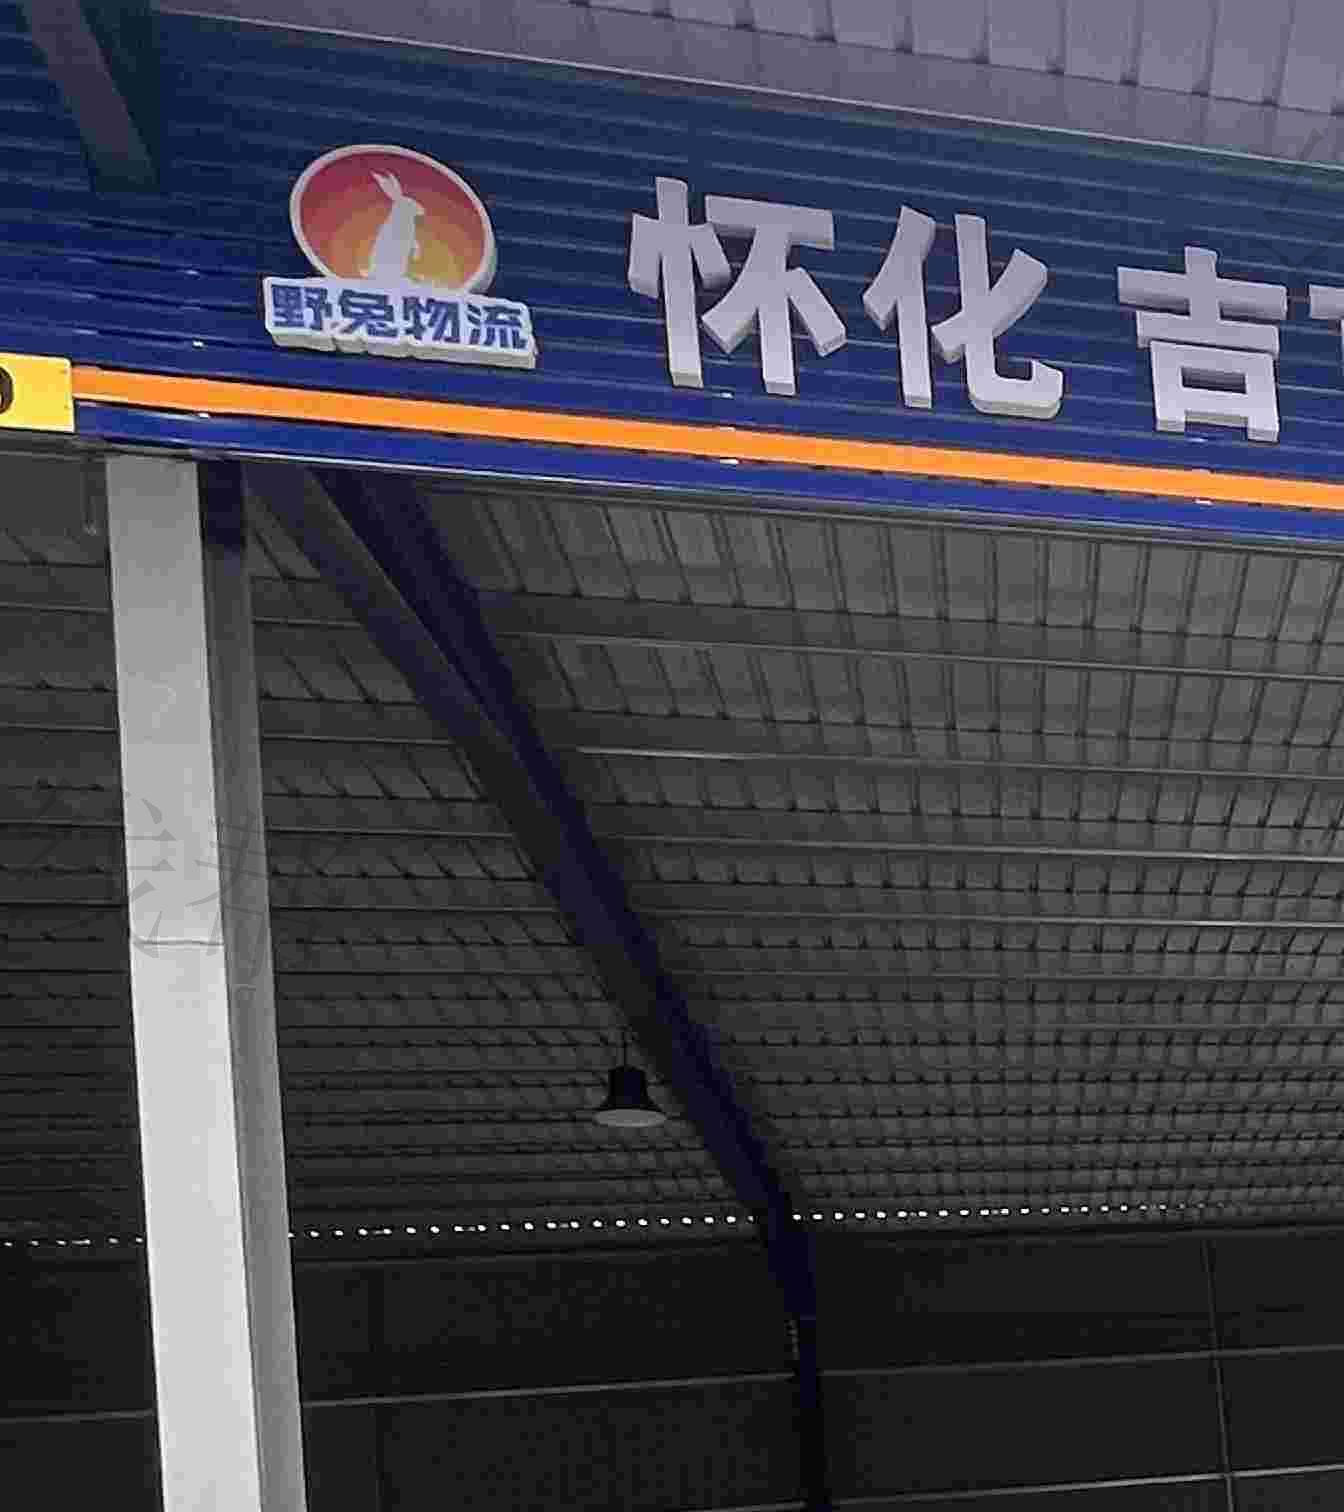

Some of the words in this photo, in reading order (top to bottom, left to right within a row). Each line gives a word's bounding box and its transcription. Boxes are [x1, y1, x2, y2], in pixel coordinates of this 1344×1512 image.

[270, 281, 530, 352] 野兔物流
[627, 175, 1066, 420] 怀化
